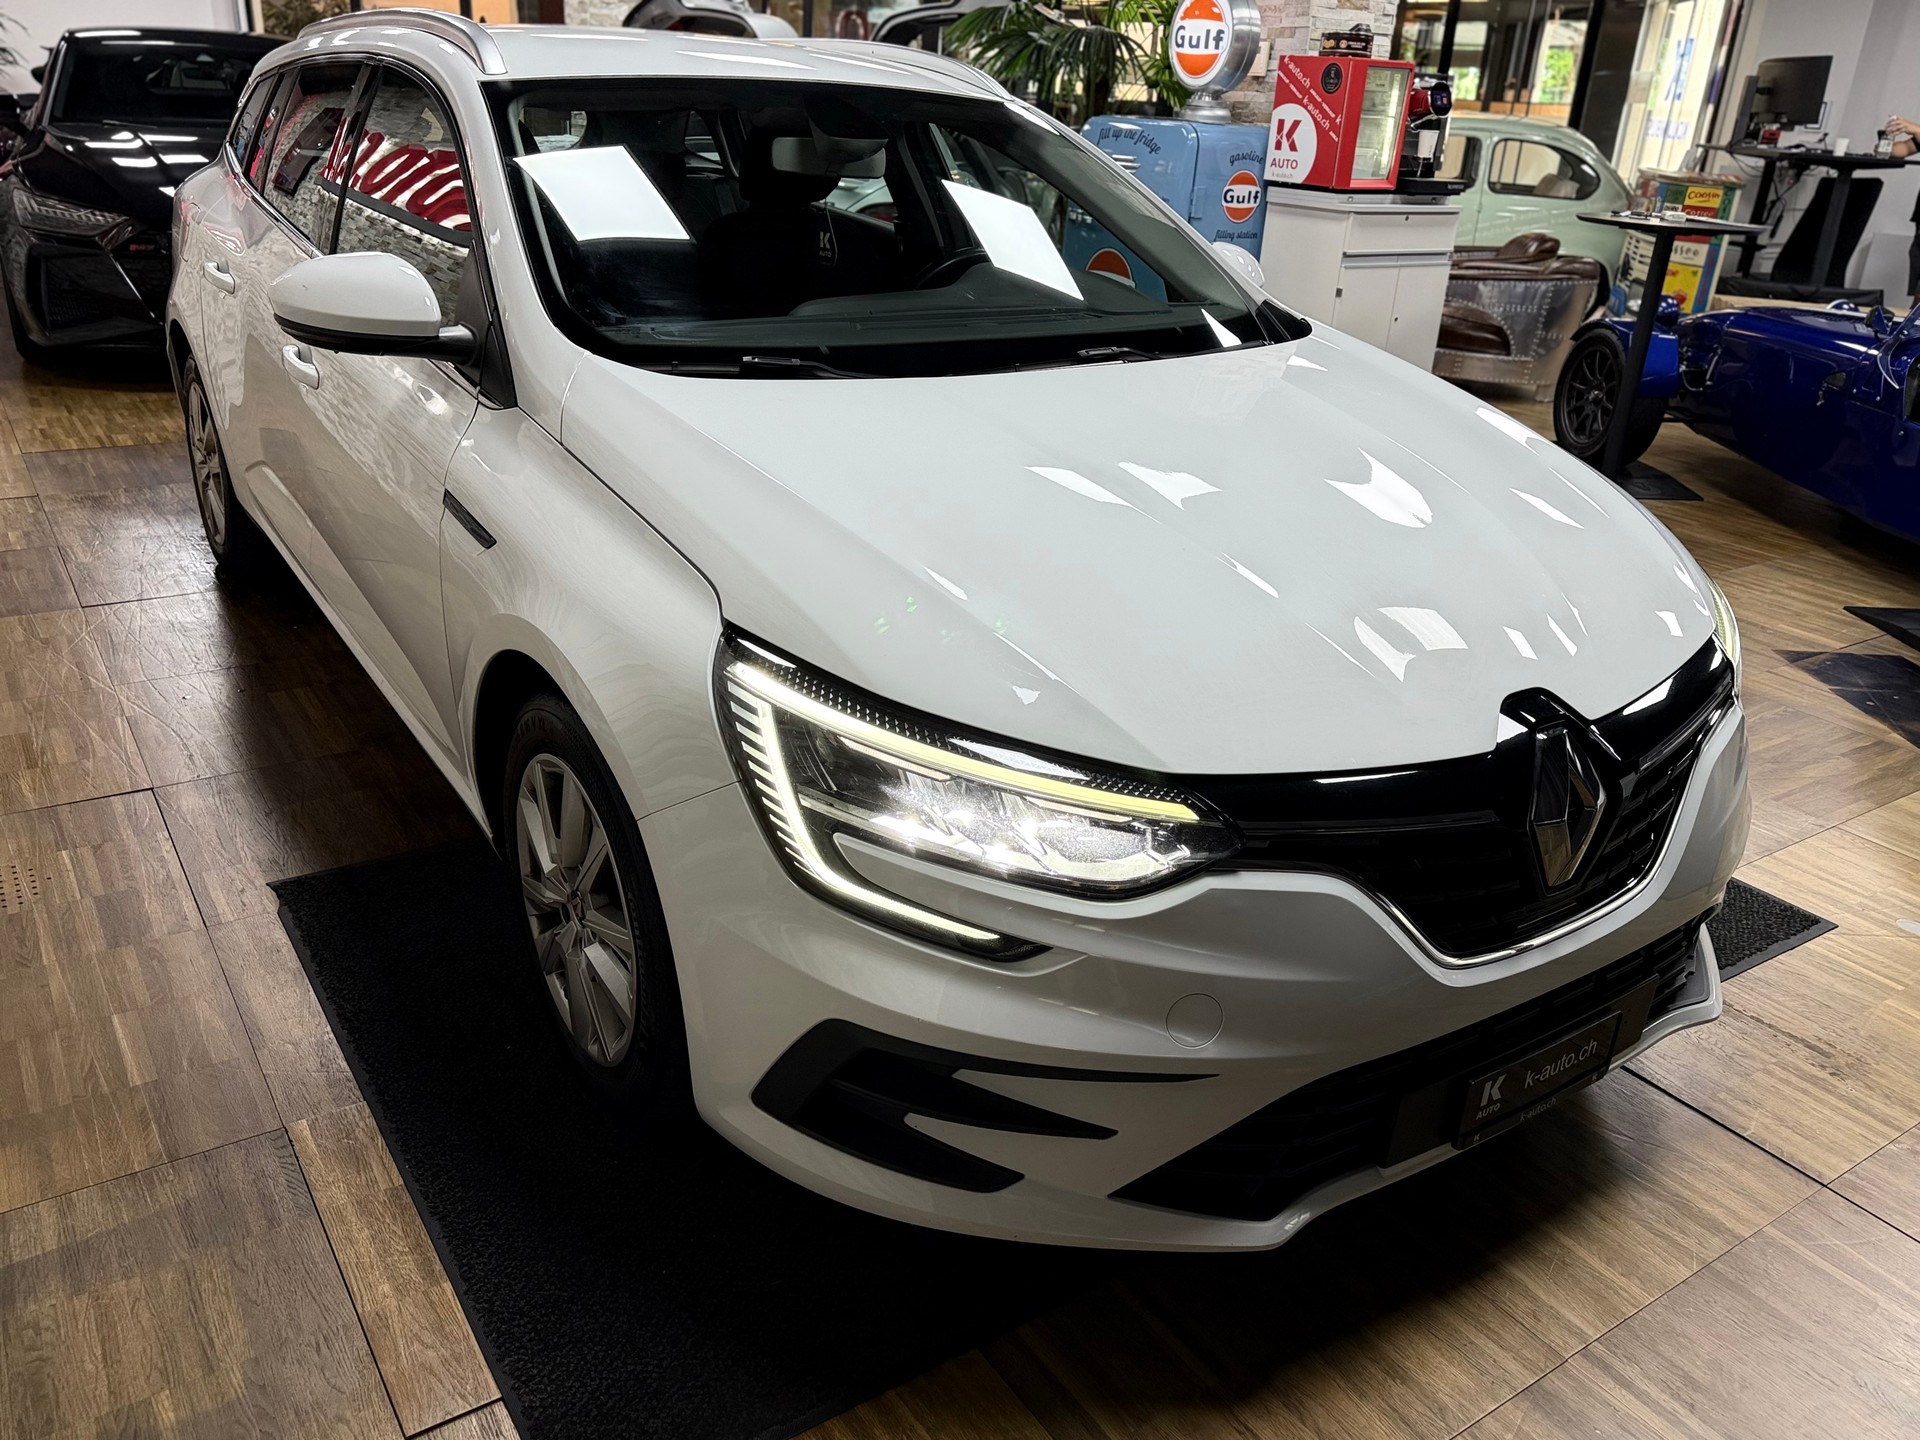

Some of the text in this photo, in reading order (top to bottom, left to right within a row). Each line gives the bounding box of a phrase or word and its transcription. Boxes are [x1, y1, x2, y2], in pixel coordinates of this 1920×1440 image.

[1175, 25, 1225, 50] Gulf
[1283, 55, 1311, 89] k-auto.ch
[1302, 95, 1330, 131] k-auto.ch
[1097, 127, 1161, 155] fill up the fridge
[1274, 118, 1302, 152] K
[1229, 150, 1264, 167] gasoline
[1270, 158, 1299, 170] AUTO
[1223, 188, 1260, 204] Gulf
[820, 231, 831, 250] K
[1214, 229, 1258, 242] filling station
[1524, 1038, 1598, 1089] k-auto.ch
[1479, 1073, 1507, 1107] K
[1475, 1102, 1501, 1121] AUTO
[1520, 1097, 1558, 1122] k-auto.ch
